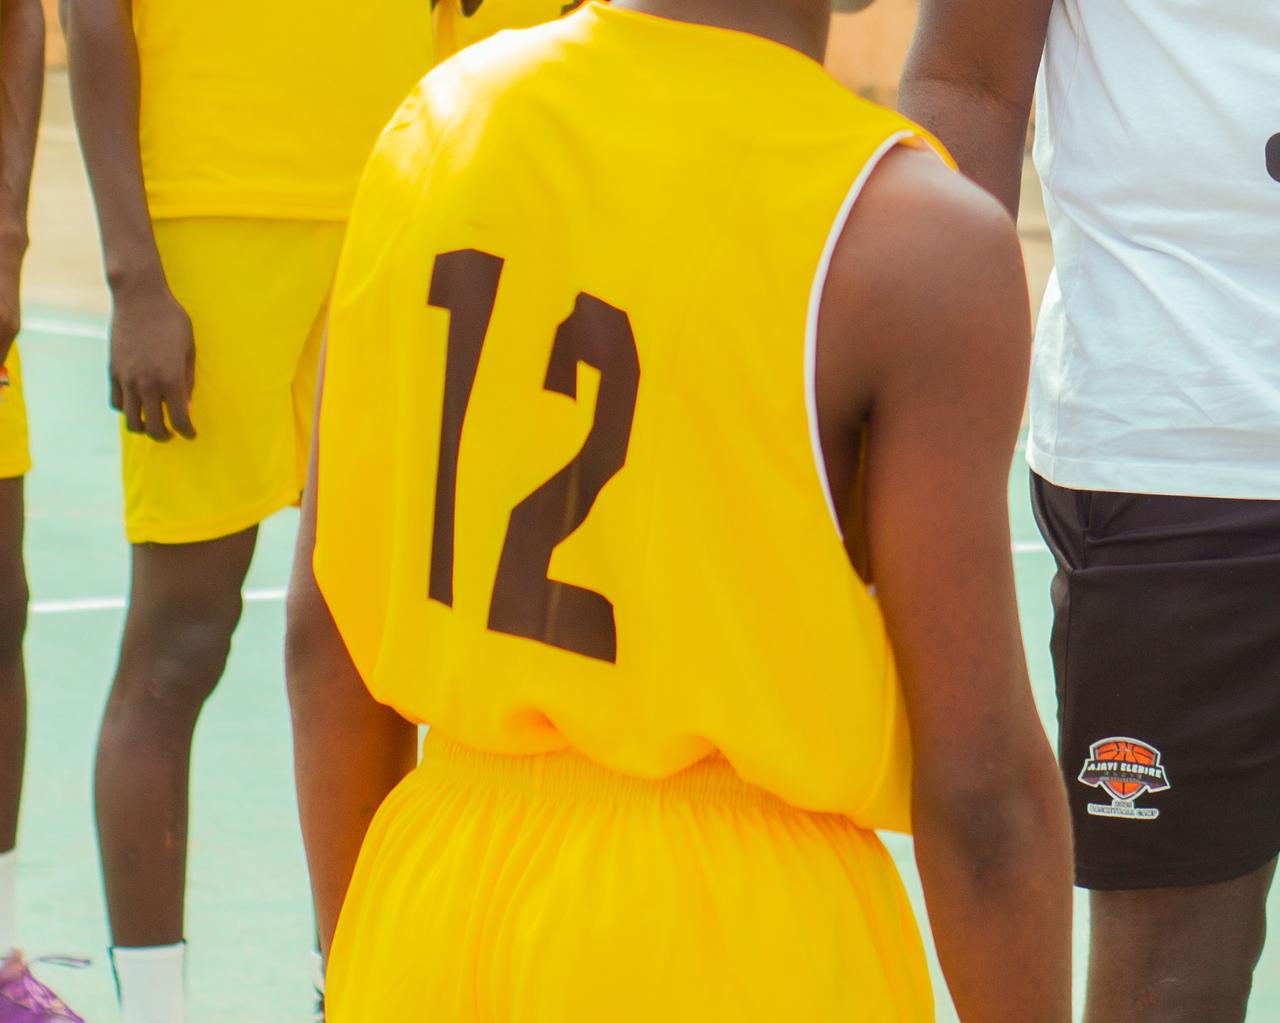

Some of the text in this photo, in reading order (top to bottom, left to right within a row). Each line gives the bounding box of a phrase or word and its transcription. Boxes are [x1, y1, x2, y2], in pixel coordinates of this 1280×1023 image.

[427, 248, 641, 665] 12
[1087, 761, 1117, 771] AJAYI
[1120, 762, 1162, 779] ELEBIRE
